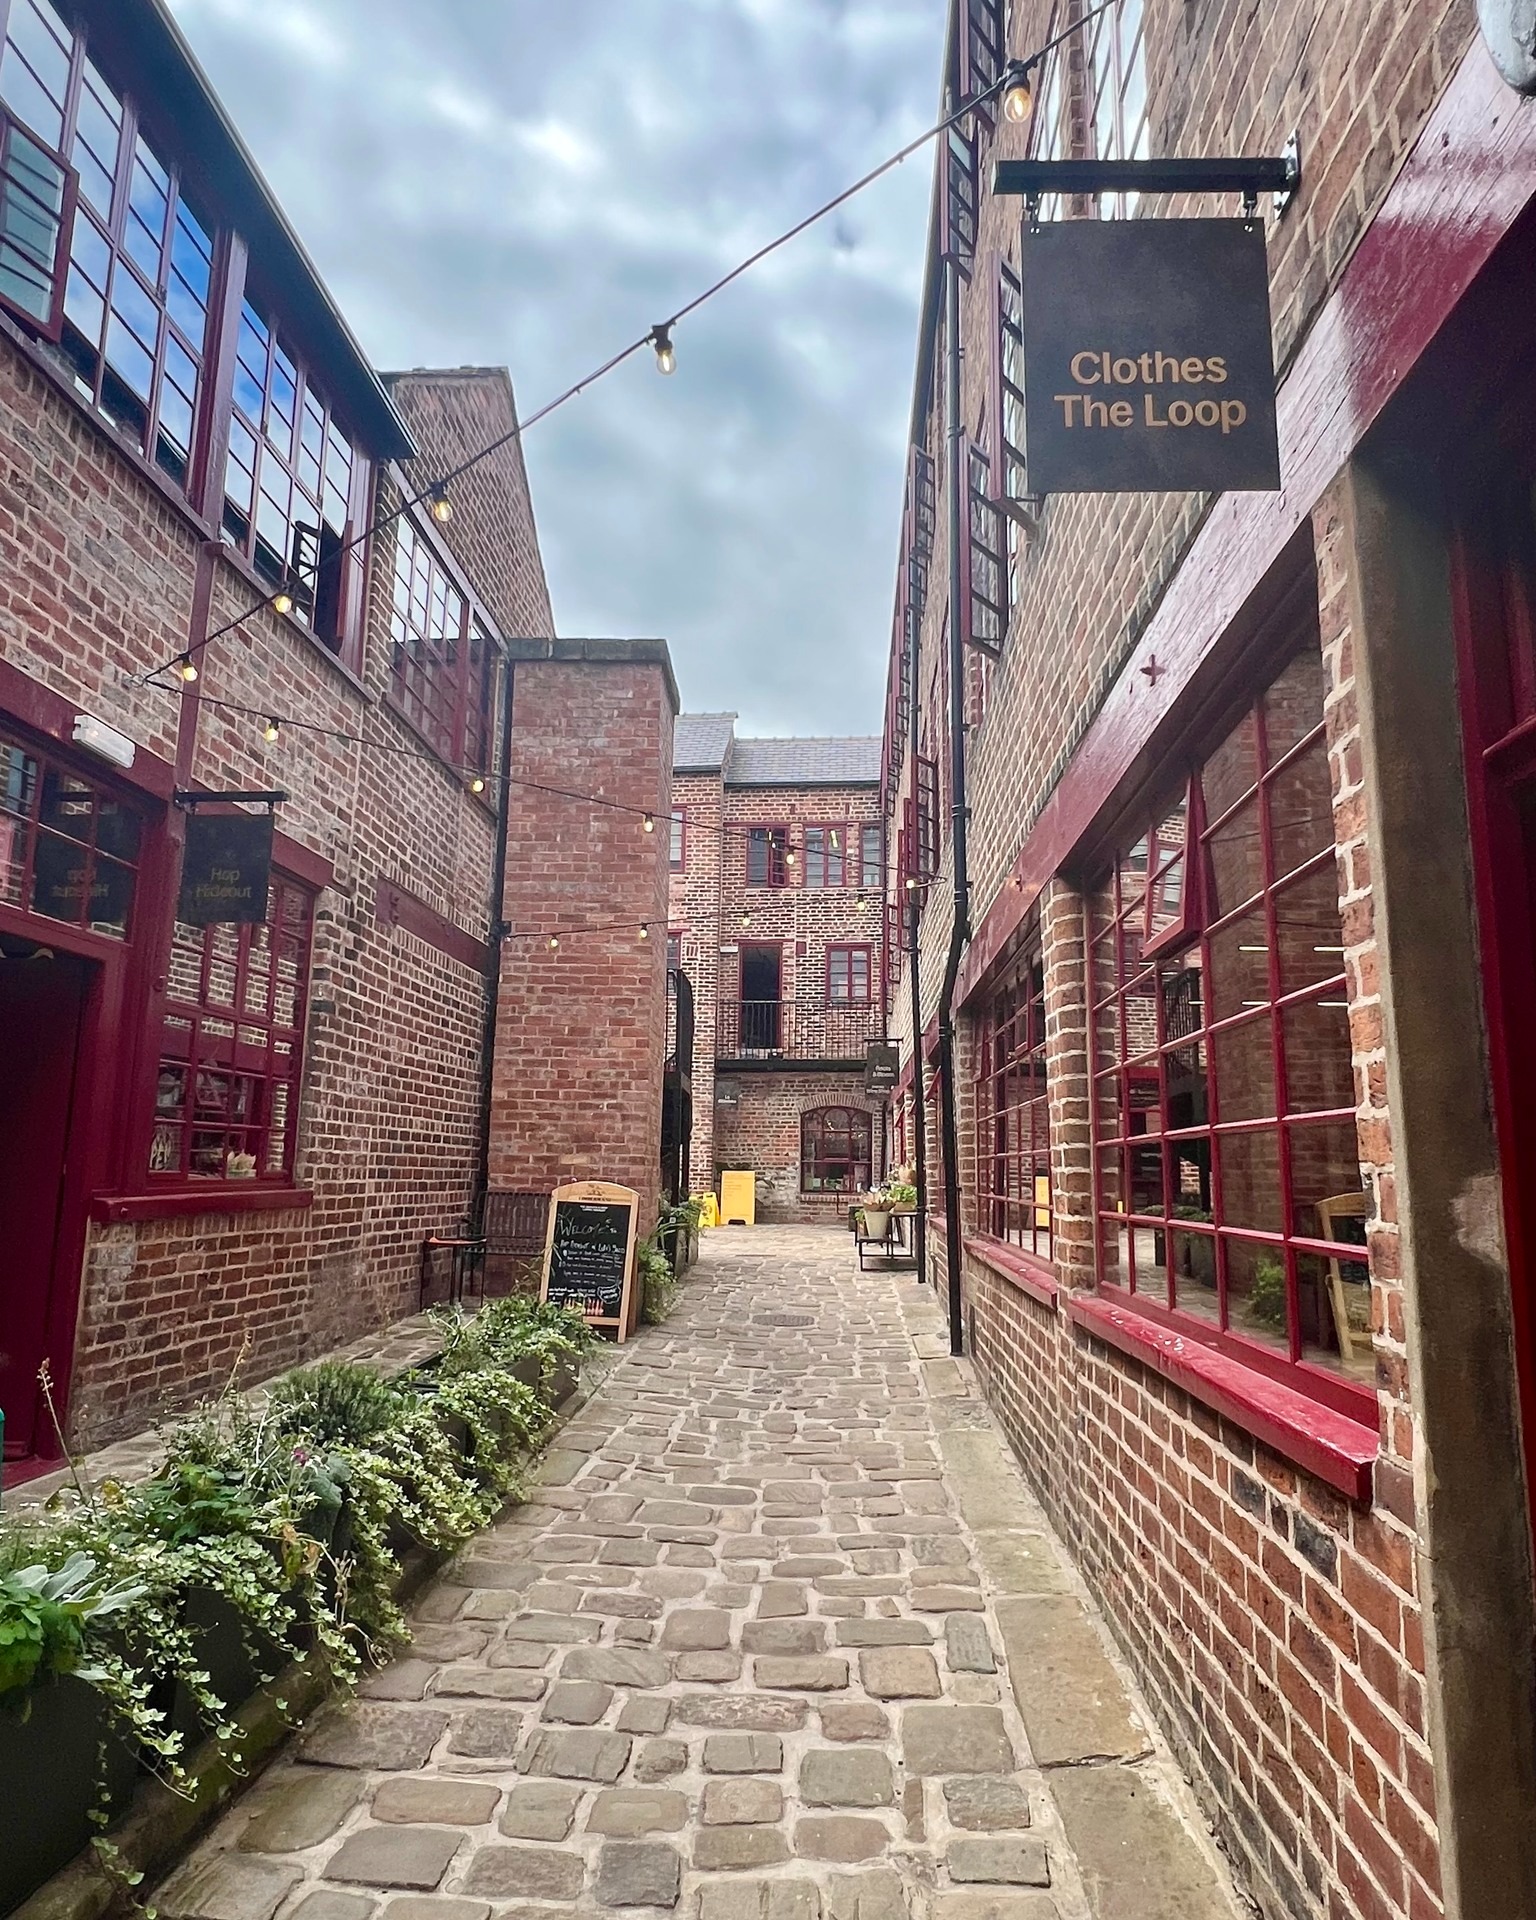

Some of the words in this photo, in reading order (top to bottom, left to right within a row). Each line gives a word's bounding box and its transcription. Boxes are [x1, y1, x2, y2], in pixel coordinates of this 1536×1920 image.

[1070, 351, 1228, 385] Clothes
[1054, 394, 1134, 428] The
[1144, 393, 1247, 434] Loop
[211, 867, 241, 884] Hop
[196, 884, 252, 898] Hideout
